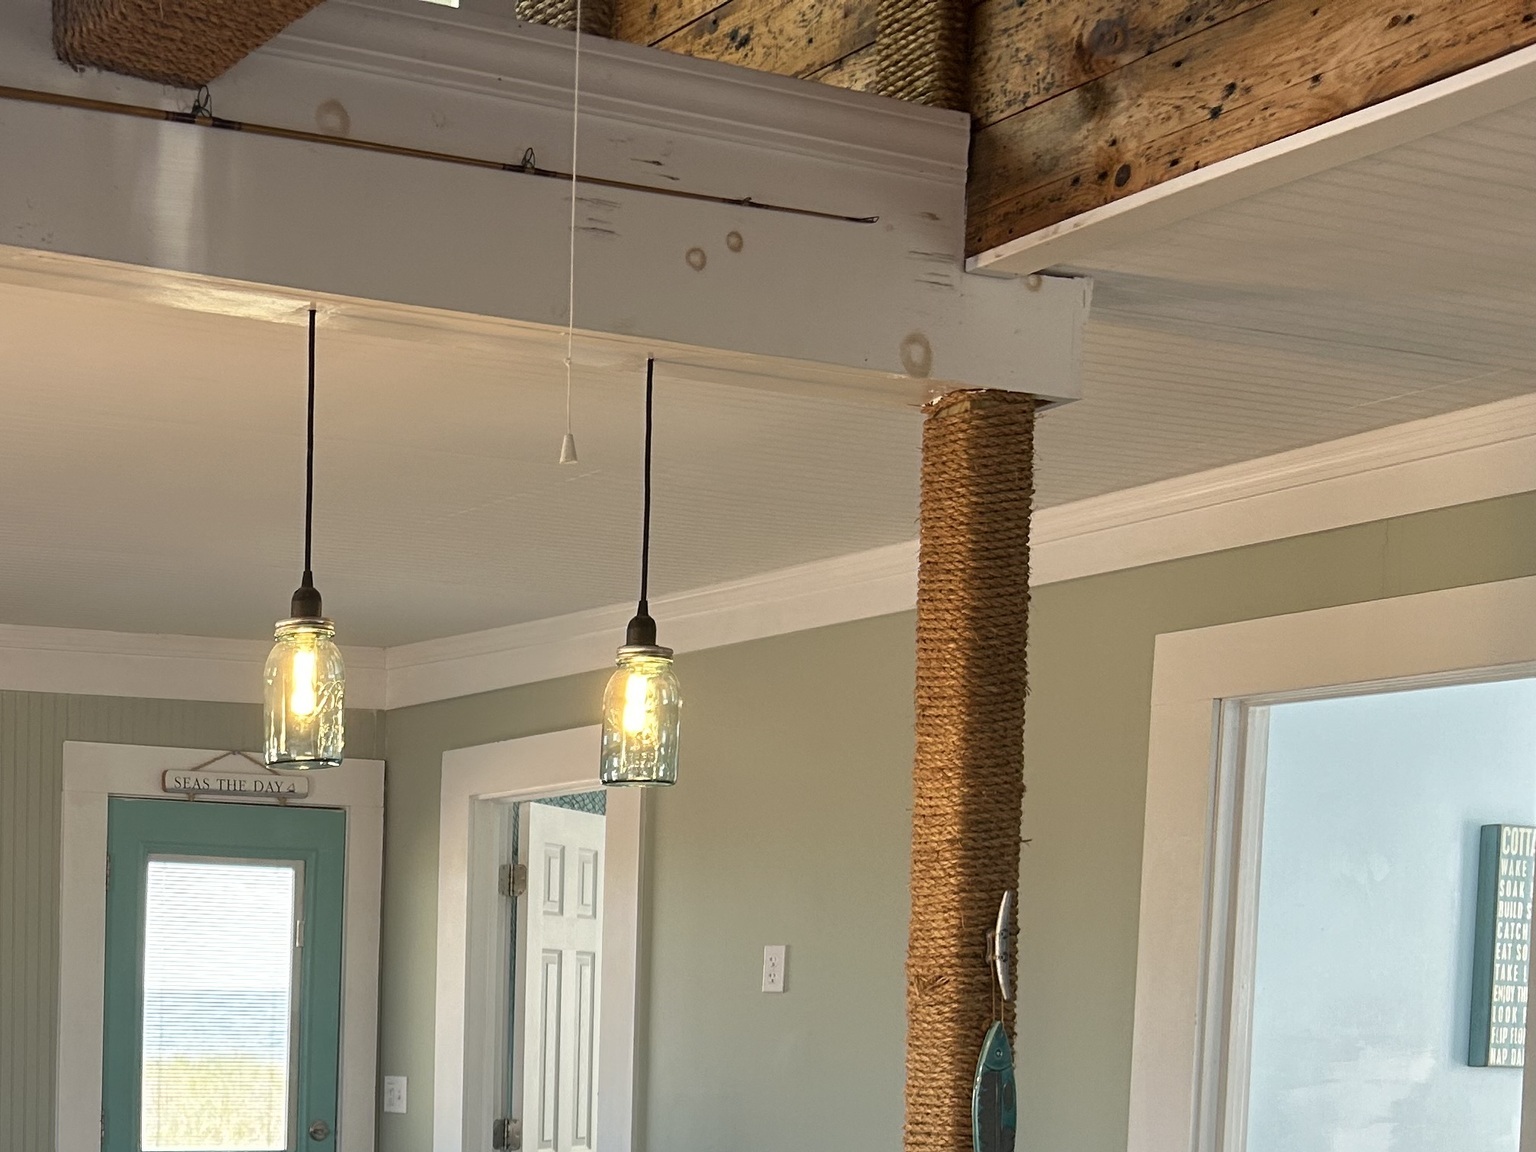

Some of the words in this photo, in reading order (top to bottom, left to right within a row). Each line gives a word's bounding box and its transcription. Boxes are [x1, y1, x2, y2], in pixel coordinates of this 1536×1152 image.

[174, 776, 210, 790] SEAS
[216, 778, 246, 792] THE
[253, 779, 284, 793] DAY
[1501, 858, 1527, 877] WAKE
[1499, 879, 1525, 898] SOAK
[1498, 901, 1523, 919] BUILD
[1497, 921, 1528, 940] CATCH
[1496, 942, 1512, 960] EAT
[1495, 963, 1518, 982] TAKE
[1493, 984, 1515, 1003] ENJOY
[1492, 1005, 1517, 1024] LOOK
[1490, 1026, 1508, 1044] FLIP
[1490, 1047, 1508, 1065] NAP
